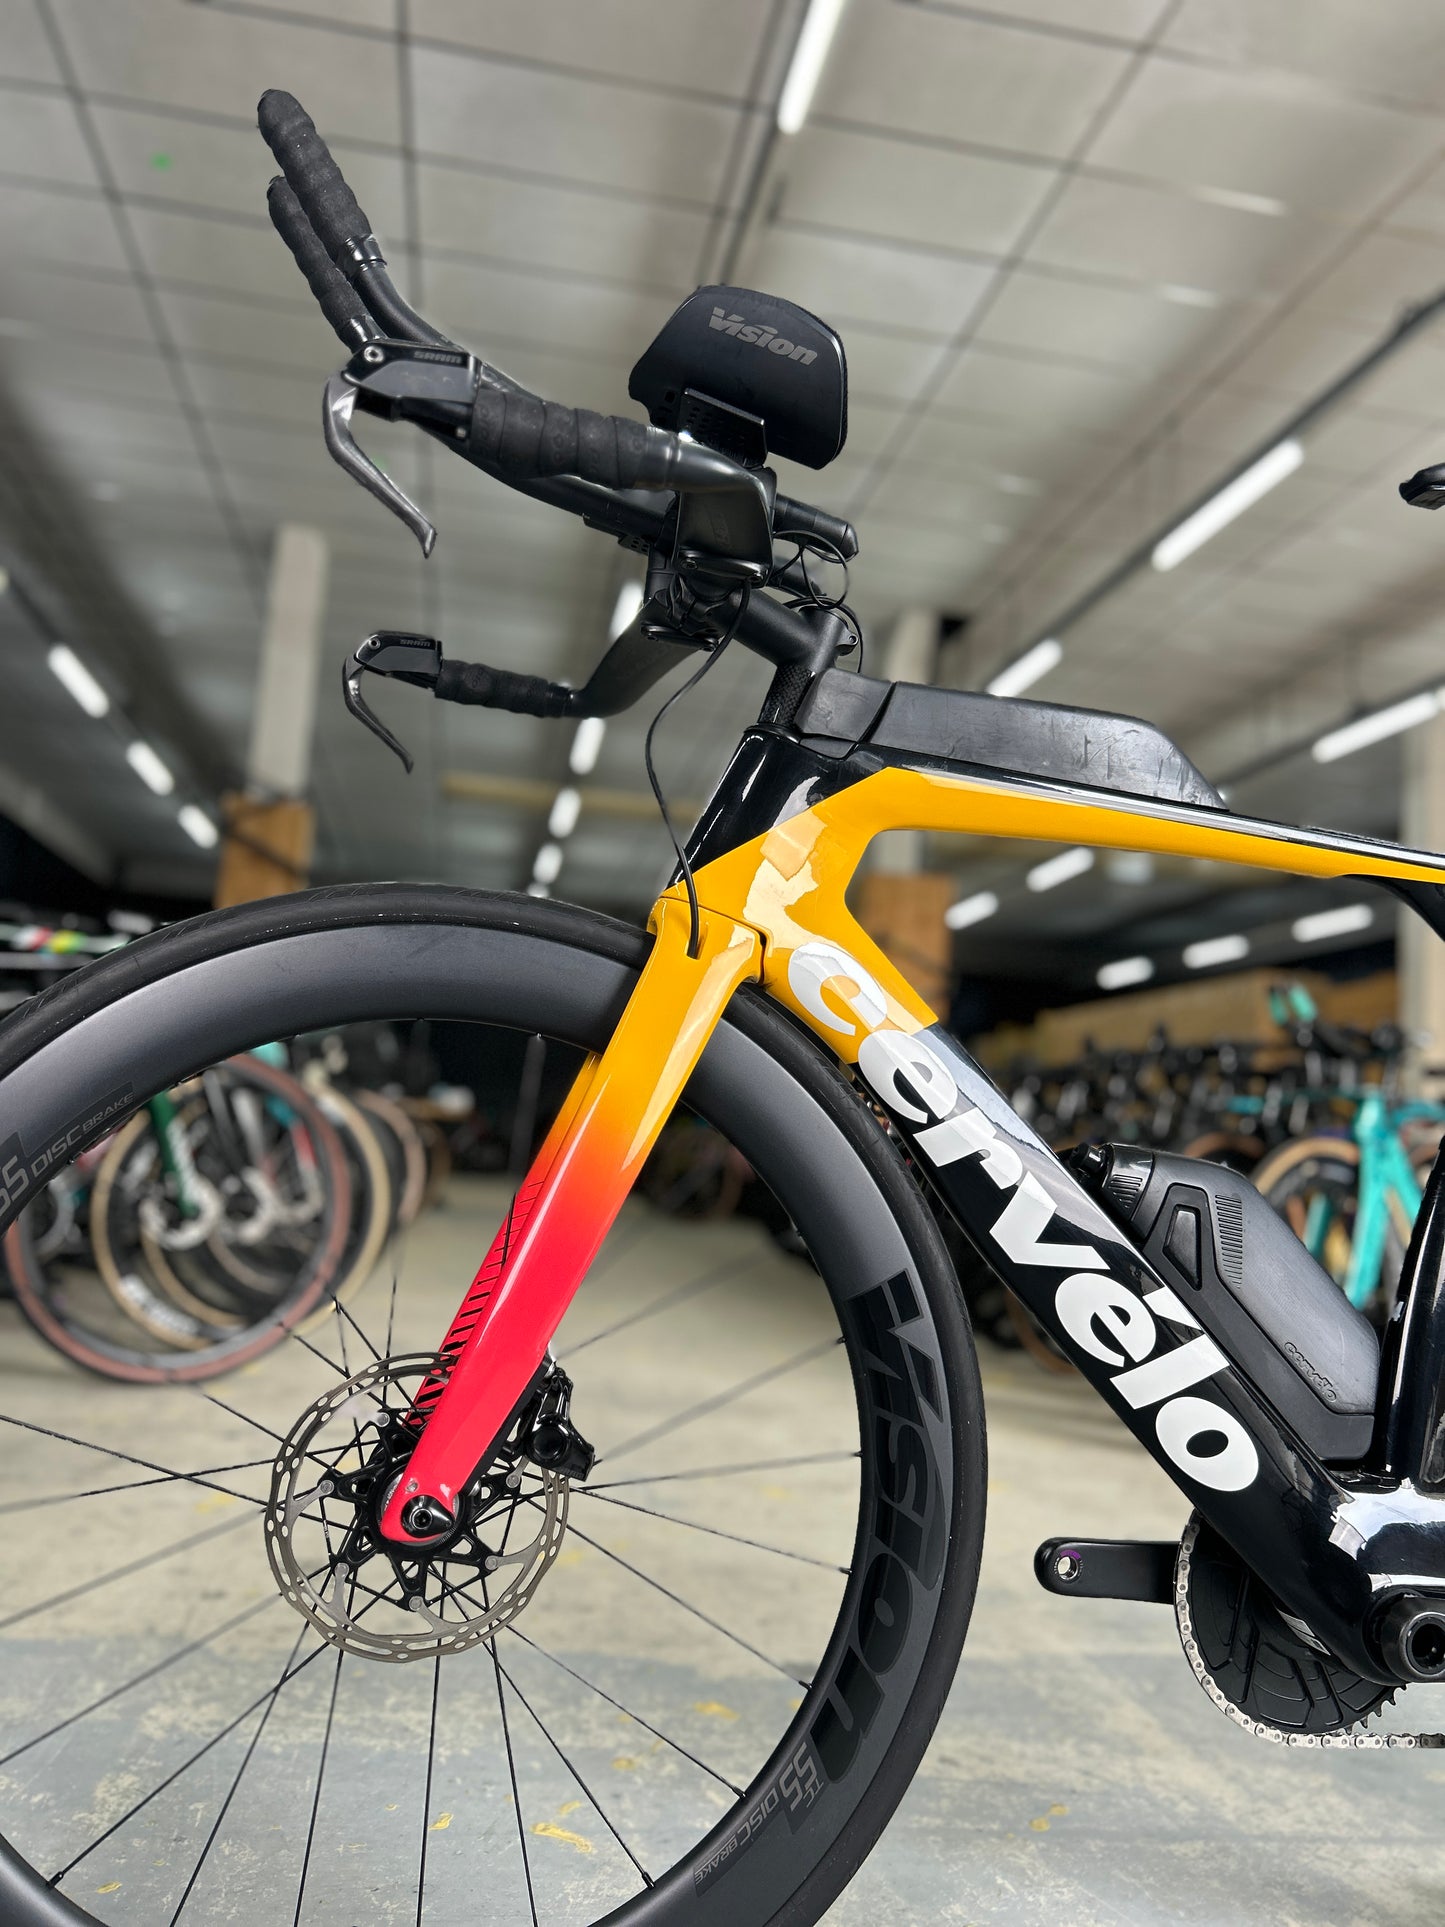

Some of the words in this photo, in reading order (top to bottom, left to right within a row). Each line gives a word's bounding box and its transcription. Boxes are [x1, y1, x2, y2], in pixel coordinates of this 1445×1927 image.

[413, 350, 462, 364] SRAM
[708, 306, 818, 366] Vision
[400, 638, 431, 647] SRAM
[30, 1125, 82, 1178] DISC
[82, 1092, 135, 1134] BRAKE
[787, 941, 1260, 1492] cervélo
[1283, 1341, 1337, 1403] cervélo
[810, 1268, 946, 1785] Vision
[778, 1742, 818, 1812] 55
[802, 1778, 824, 1808] TC
[737, 1787, 780, 1846] DISC
[694, 1834, 739, 1885] BRAKE
